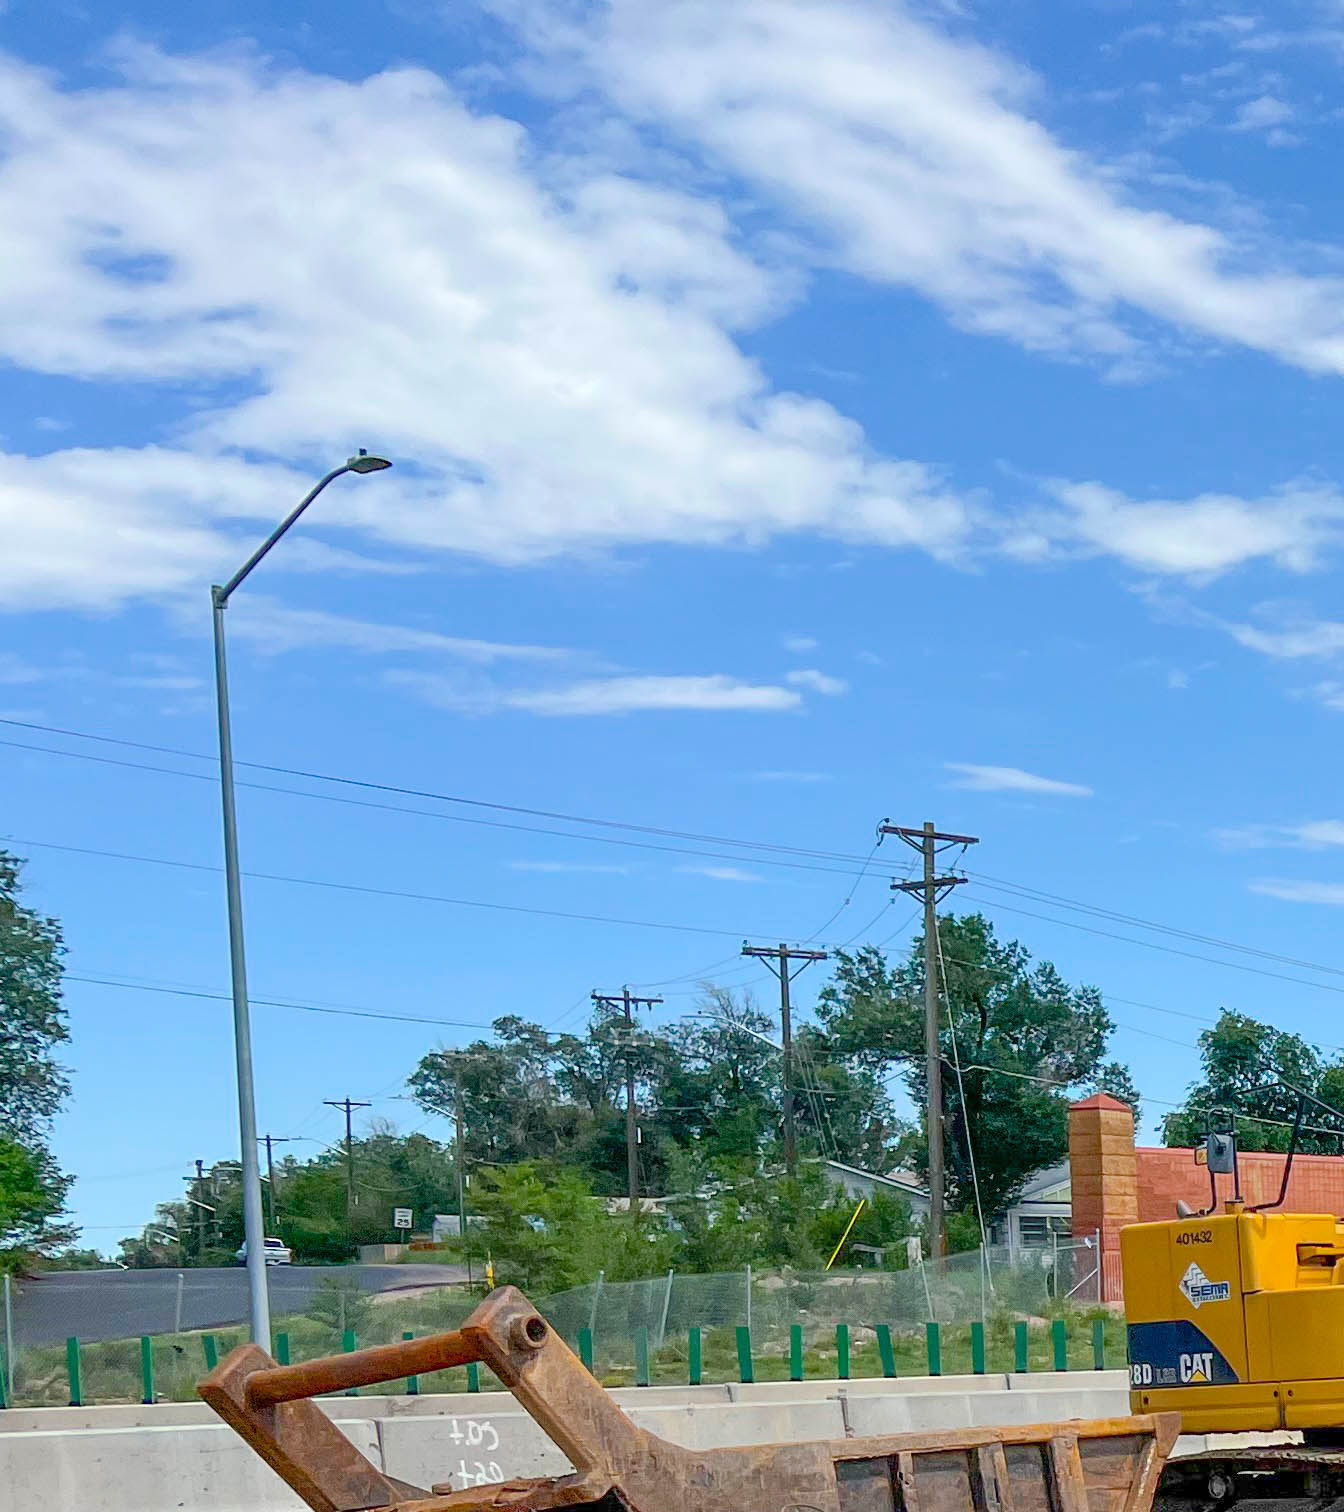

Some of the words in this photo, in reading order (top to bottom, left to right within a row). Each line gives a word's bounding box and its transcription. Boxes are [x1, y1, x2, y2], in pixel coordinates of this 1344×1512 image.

[397, 1218, 410, 1227] 25
[1176, 1230, 1213, 1245] 401432
[1191, 1283, 1229, 1297] SEMA
[1180, 1352, 1214, 1384] CAT
